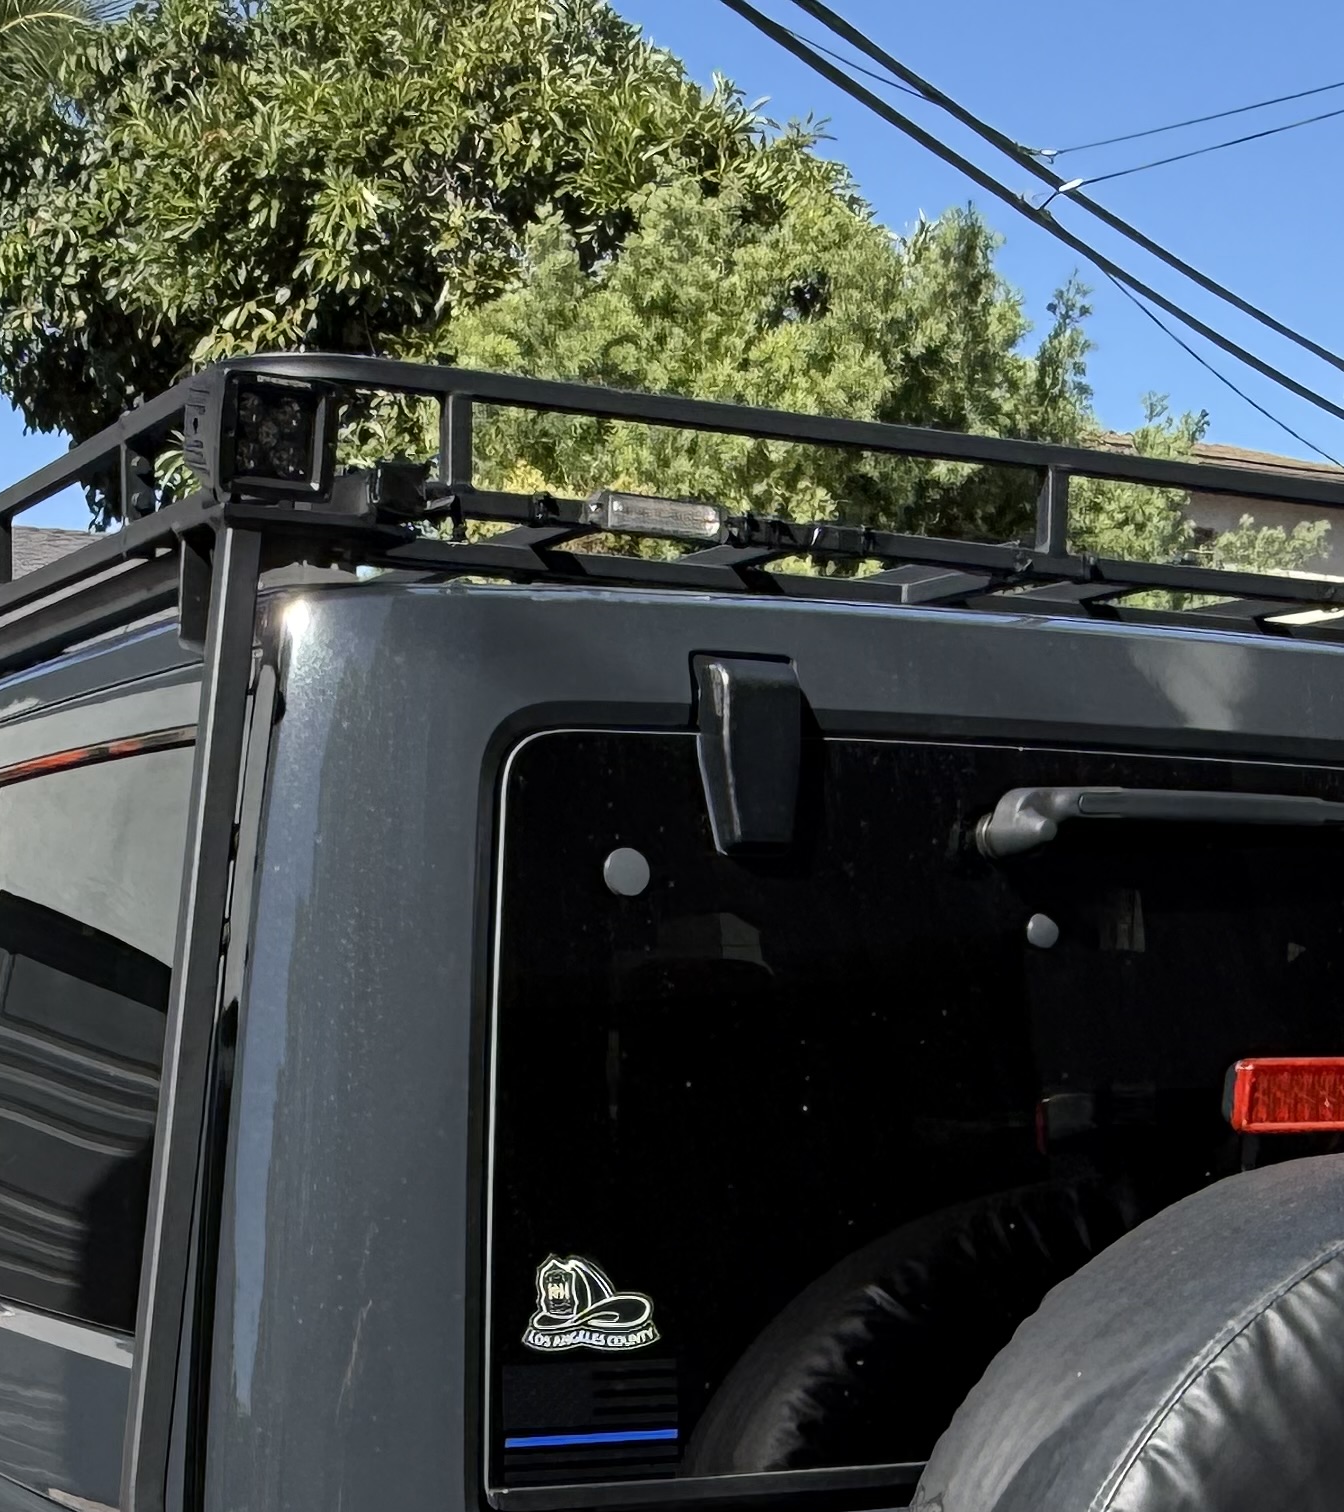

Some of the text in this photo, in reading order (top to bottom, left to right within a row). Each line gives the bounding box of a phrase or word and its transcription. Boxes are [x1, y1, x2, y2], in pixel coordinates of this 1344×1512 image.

[528, 1327, 653, 1347] LOS ANGELES COUNTY
